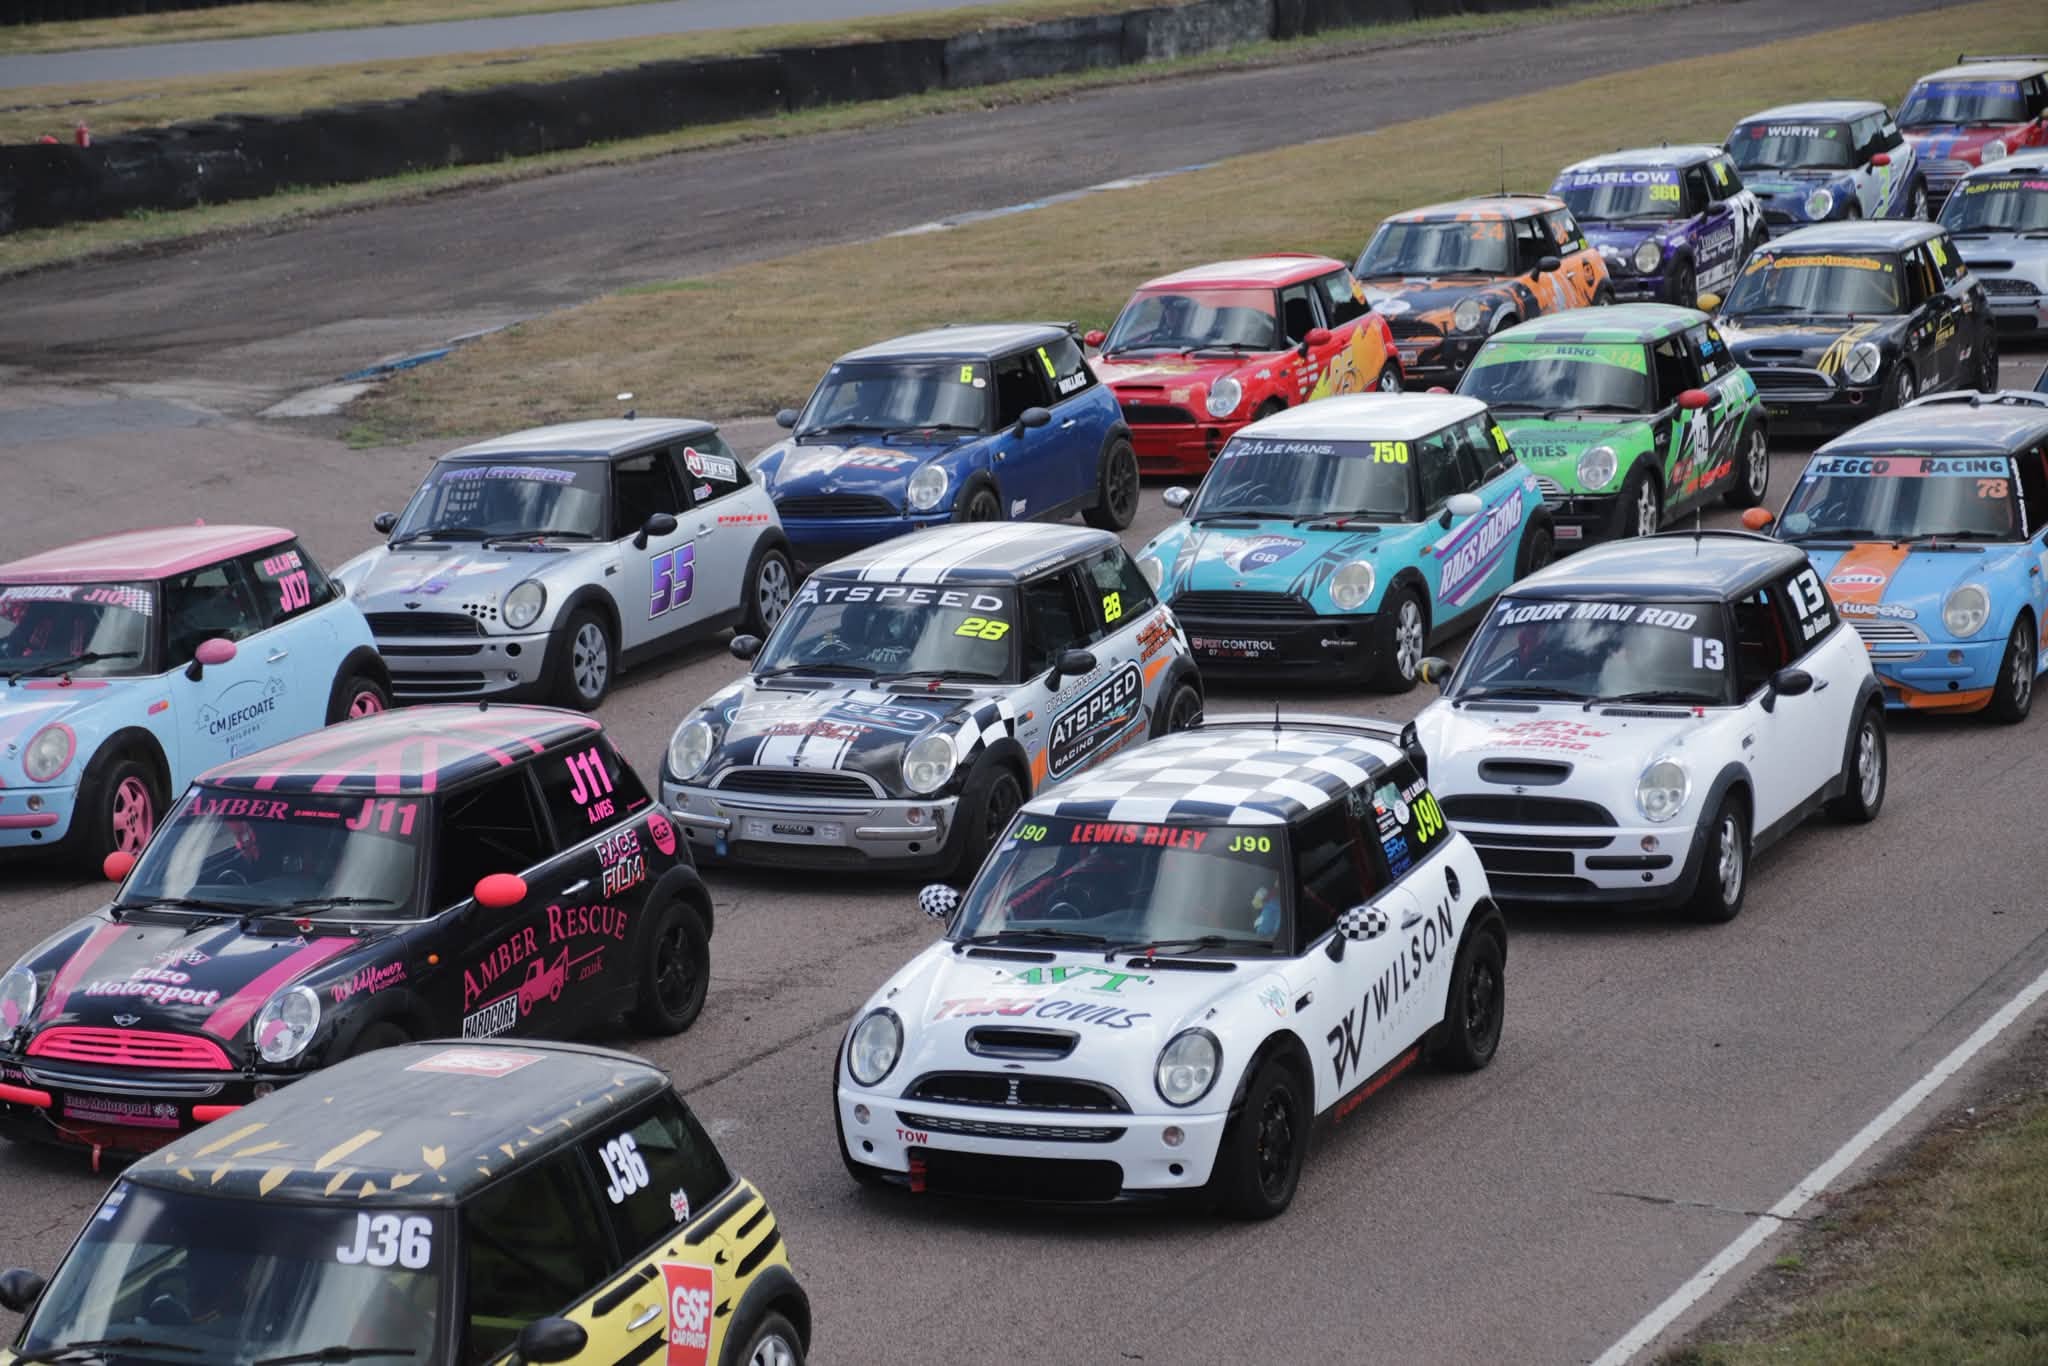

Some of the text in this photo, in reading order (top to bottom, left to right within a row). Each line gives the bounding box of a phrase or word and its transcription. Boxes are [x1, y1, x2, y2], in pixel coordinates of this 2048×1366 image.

[1574, 171, 1670, 185] BARLOW
[1650, 184, 1681, 201] 360
[1471, 223, 1504, 240] 24
[960, 365, 973, 384] 6
[1370, 442, 1408, 463] 750
[1920, 459, 2004, 473] RACING
[1976, 479, 2009, 498] 73
[1251, 552, 1279, 563] GB
[1438, 535, 1478, 600] RAGS
[1477, 487, 1522, 564] RACING
[278, 570, 311, 613] J107
[649, 540, 696, 620] 55
[1787, 569, 1825, 620] 13
[795, 586, 1004, 611] ATSPEED
[1103, 592, 1122, 623] 28
[954, 617, 1009, 641] 28
[1498, 603, 1697, 631] KOOR MINI ROD
[1692, 637, 1725, 671] 13
[209, 697, 275, 736] CM JEFCOATE
[1053, 670, 1136, 749] ATSPEED
[1055, 735, 1094, 769] RACING
[565, 747, 614, 805] J11
[182, 796, 417, 836] AMBER J11
[1412, 792, 1442, 843] J90
[594, 828, 640, 868] RACE
[1013, 823, 1271, 853] J90 LEWIS RILEY J90
[602, 855, 645, 898] FILM
[127, 966, 191, 984] Enzo
[463, 904, 628, 1013] AMBER RESCUE
[1372, 896, 1454, 1024] WILSON
[85, 979, 220, 1007] Motorsport
[464, 997, 516, 1039] HARDCORE
[1036, 1000, 1152, 1029] CIVILS
[896, 1129, 928, 1144] TOW
[598, 1132, 650, 1204] J36
[336, 1212, 433, 1269] J36
[672, 1285, 710, 1332] GSF
